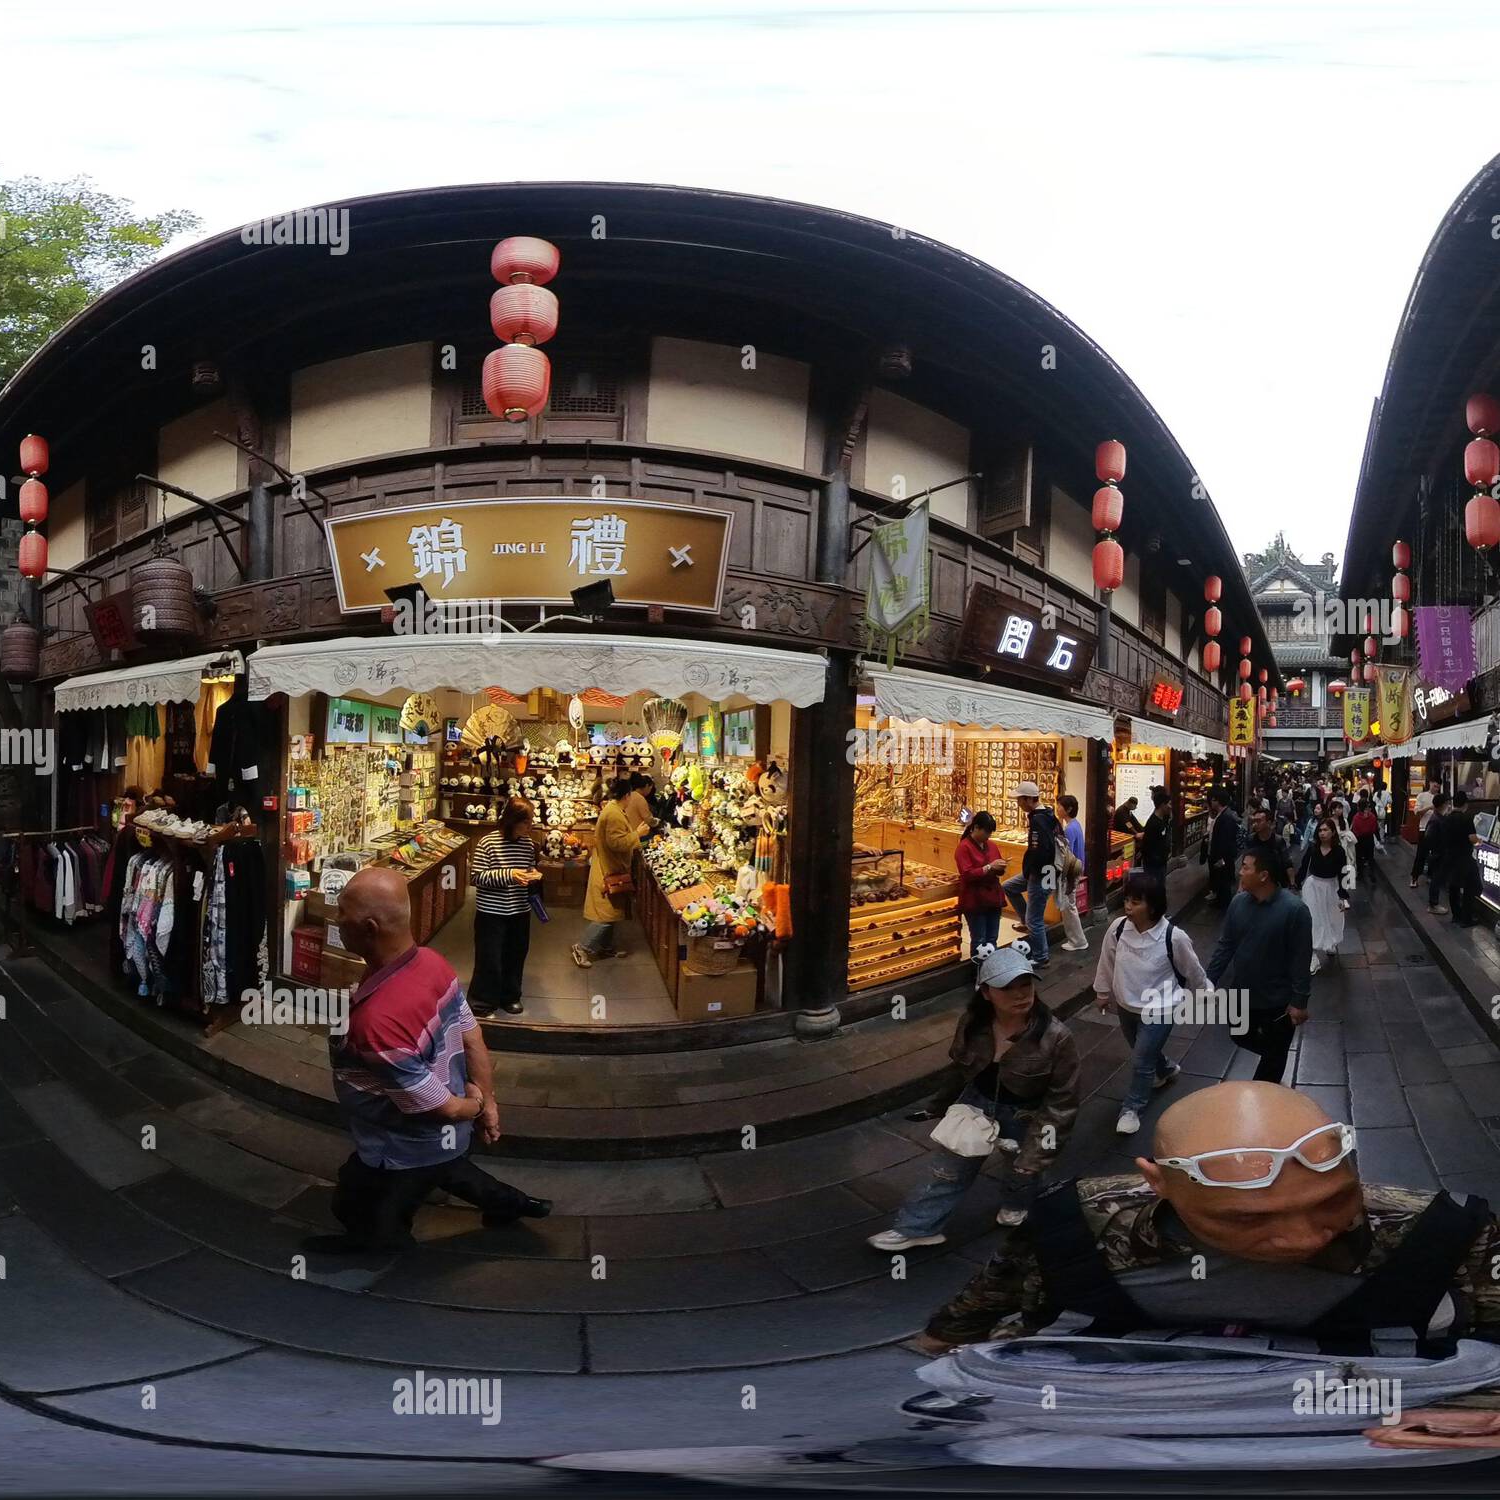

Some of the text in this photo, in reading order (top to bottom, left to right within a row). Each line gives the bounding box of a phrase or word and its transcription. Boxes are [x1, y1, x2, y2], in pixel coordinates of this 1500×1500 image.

[406, 512, 629, 590] 錦 JING LI 禮
